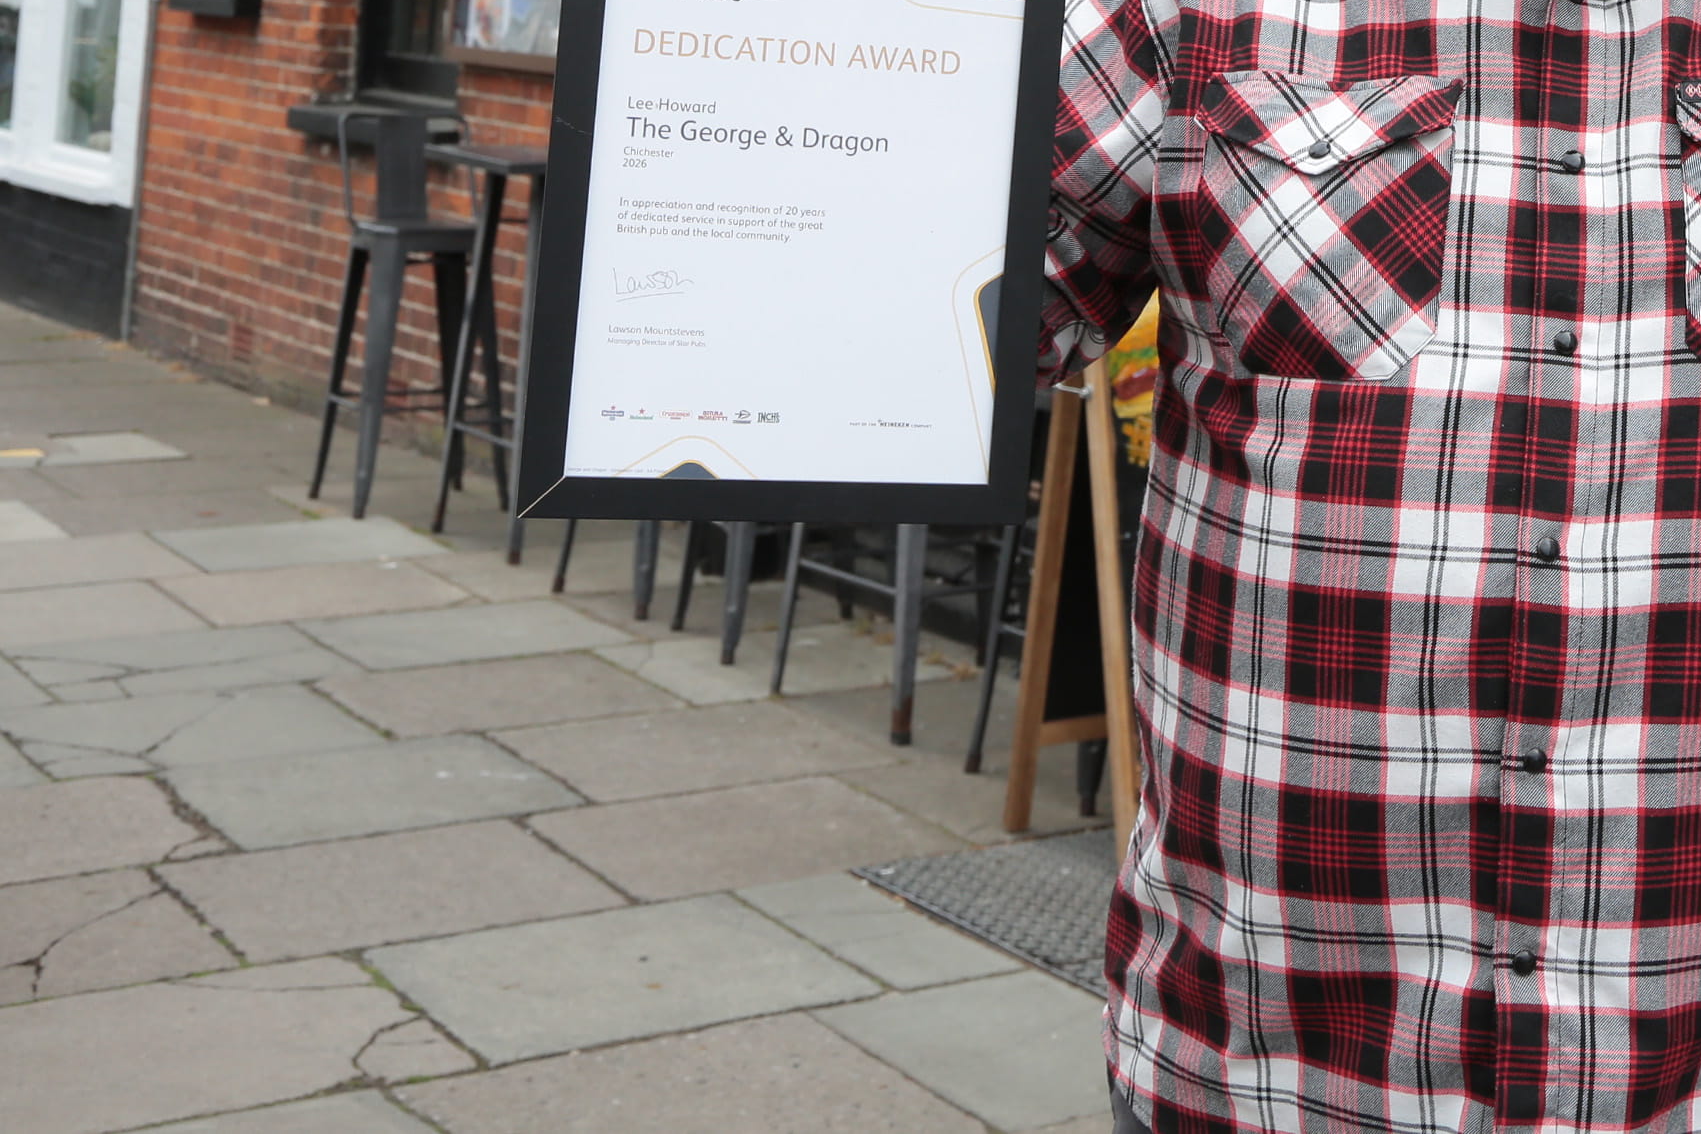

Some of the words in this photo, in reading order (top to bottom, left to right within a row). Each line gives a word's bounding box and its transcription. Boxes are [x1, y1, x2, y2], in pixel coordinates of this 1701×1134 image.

[634, 28, 836, 67] DEDICATION
[848, 44, 961, 75] AWARD
[627, 96, 654, 110] Lee
[659, 97, 717, 114] Howard
[626, 116, 671, 140] The
[680, 120, 767, 150] George
[775, 125, 794, 147] &
[803, 128, 889, 156] Dragon
[623, 146, 675, 158] Chichester
[622, 158, 647, 168] 2026
[619, 197, 629, 207] In
[632, 199, 693, 211] appreciation
[696, 202, 714, 211] and
[717, 204, 770, 216] recognition
[773, 206, 782, 215] of
[785, 206, 798, 216] 20
[800, 208, 826, 219] years
[617, 210, 629, 220] of
[630, 212, 679, 223] dedicated
[681, 215, 714, 225] service
[717, 216, 726, 226] in
[728, 218, 765, 229] support
[767, 218, 777, 228] of
[780, 219, 796, 229] the
[798, 221, 823, 233] great
[617, 224, 647, 234] British
[650, 226, 668, 237] pub
[671, 227, 690, 237] and
[693, 228, 708, 238] the
[711, 229, 733, 239] local
[736, 232, 791, 244] community.
[608, 324, 641, 335] Lawson
[644, 326, 705, 337] Mountstevens
[608, 337, 640, 346] Managing
